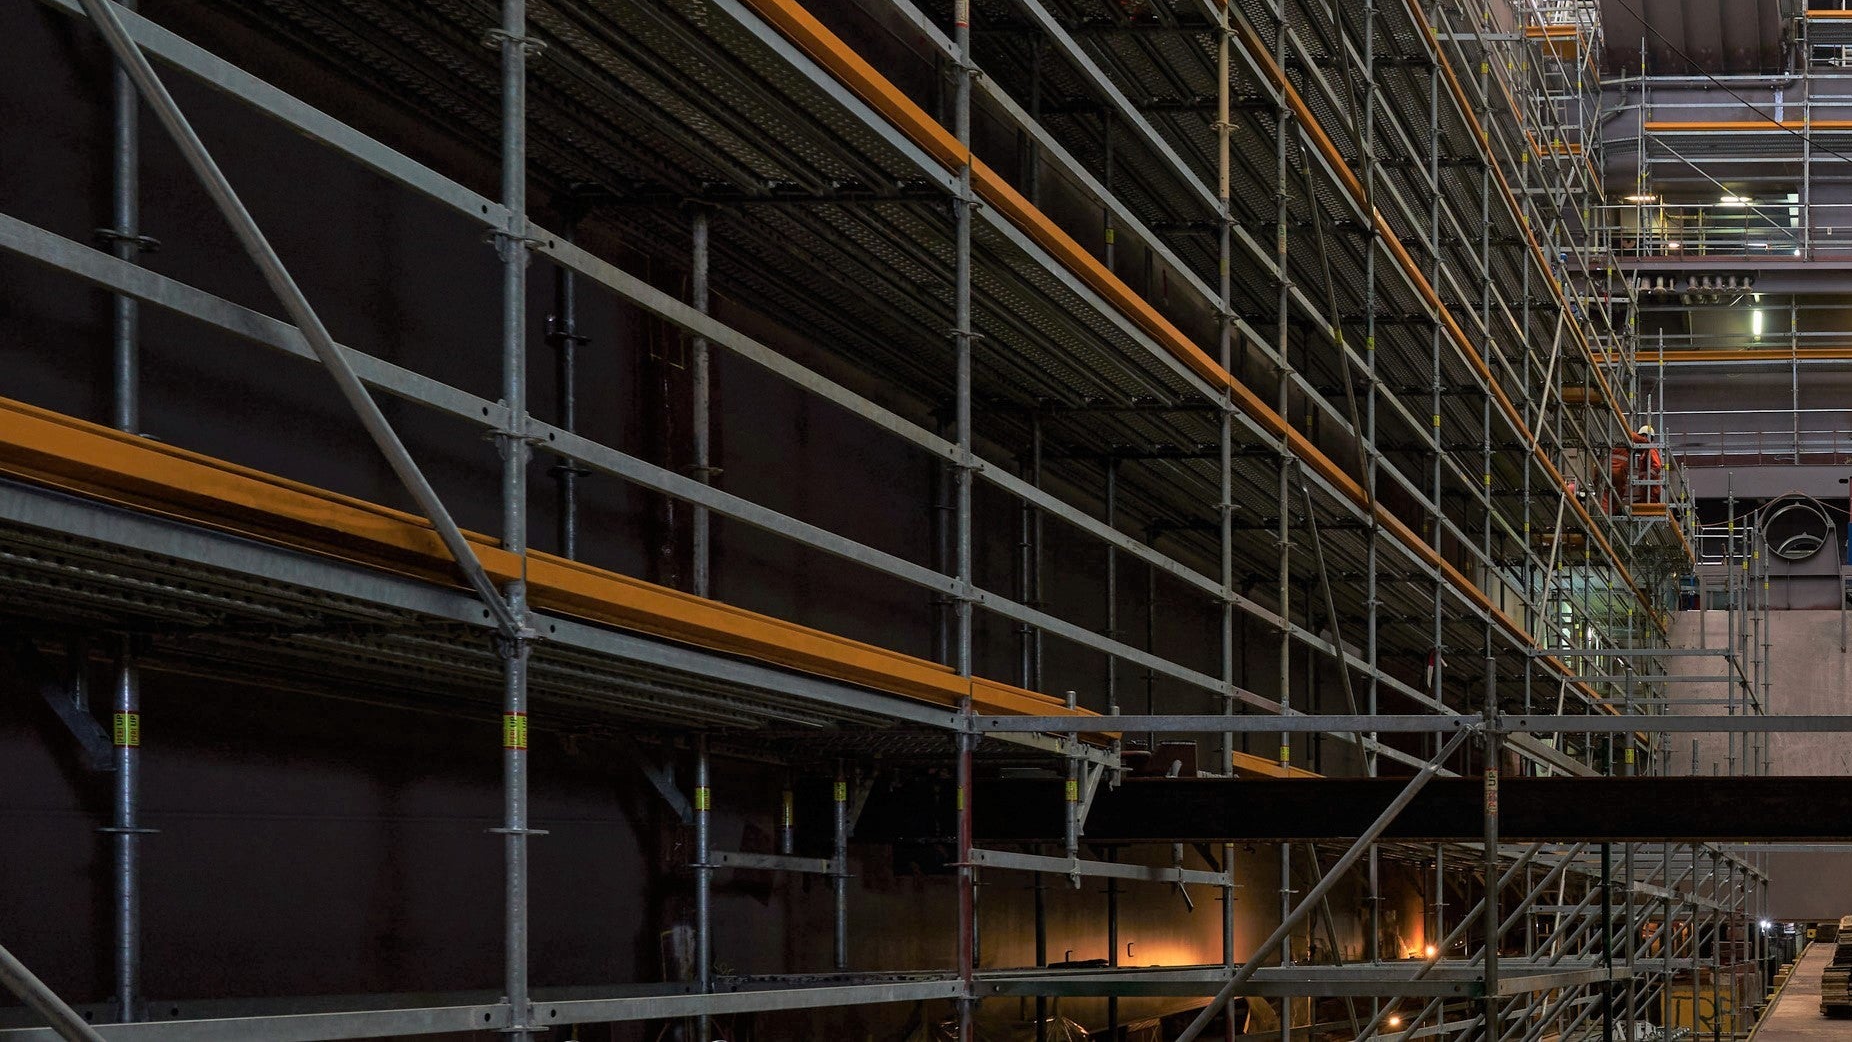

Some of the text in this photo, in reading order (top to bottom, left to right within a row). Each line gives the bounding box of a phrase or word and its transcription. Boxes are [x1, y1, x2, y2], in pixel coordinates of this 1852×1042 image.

[117, 714, 124, 726] UP
[510, 716, 517, 728] UP
[1488, 771, 1497, 786] UP
